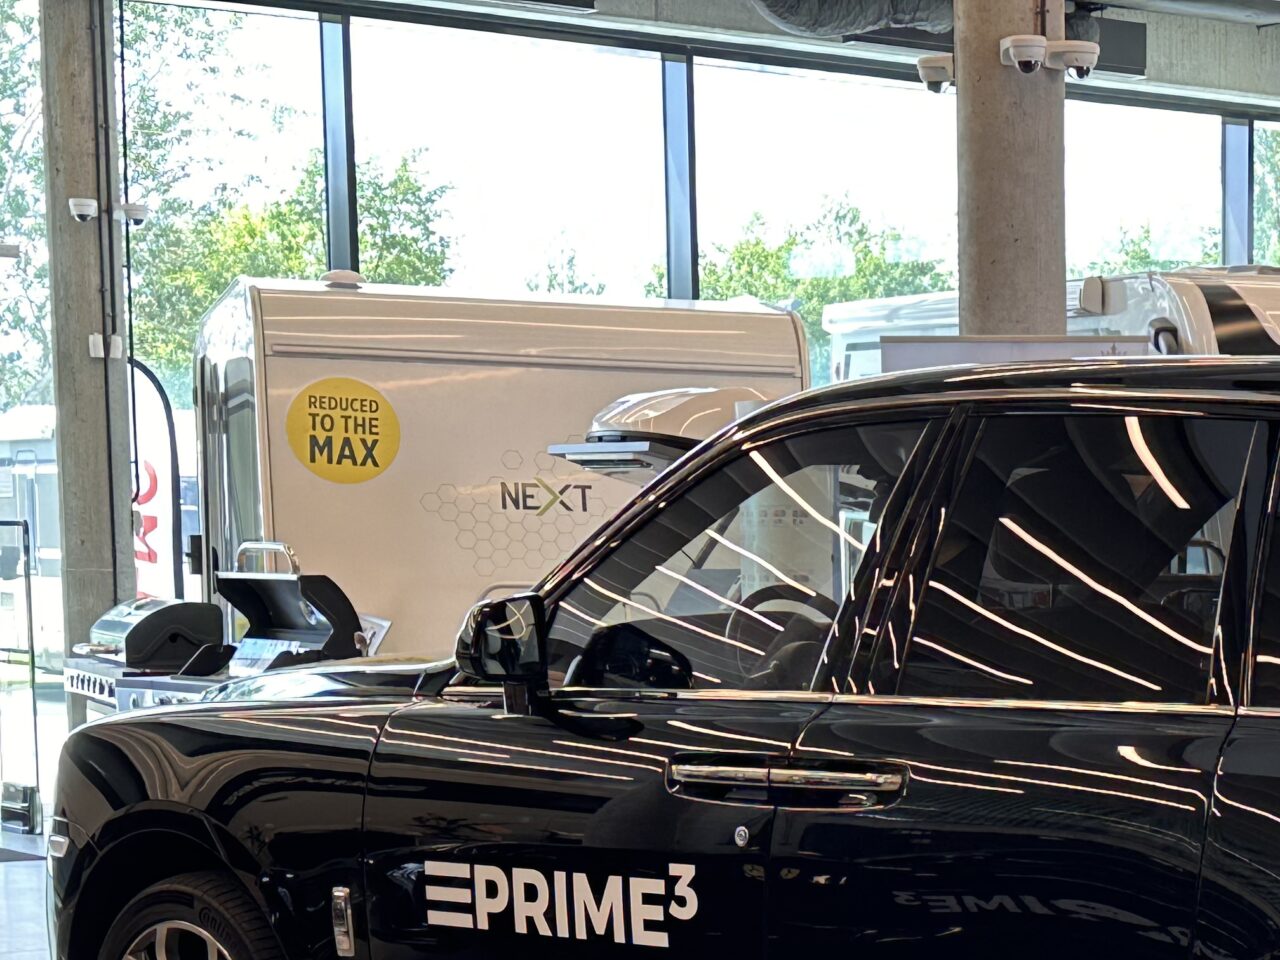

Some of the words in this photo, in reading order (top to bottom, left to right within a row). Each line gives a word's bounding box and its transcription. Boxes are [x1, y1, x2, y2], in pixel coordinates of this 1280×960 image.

[308, 395, 379, 413] REDUCED
[308, 413, 335, 432] TO
[340, 415, 380, 436] THE
[309, 434, 380, 468] MAX
[500, 476, 592, 516] NEXT
